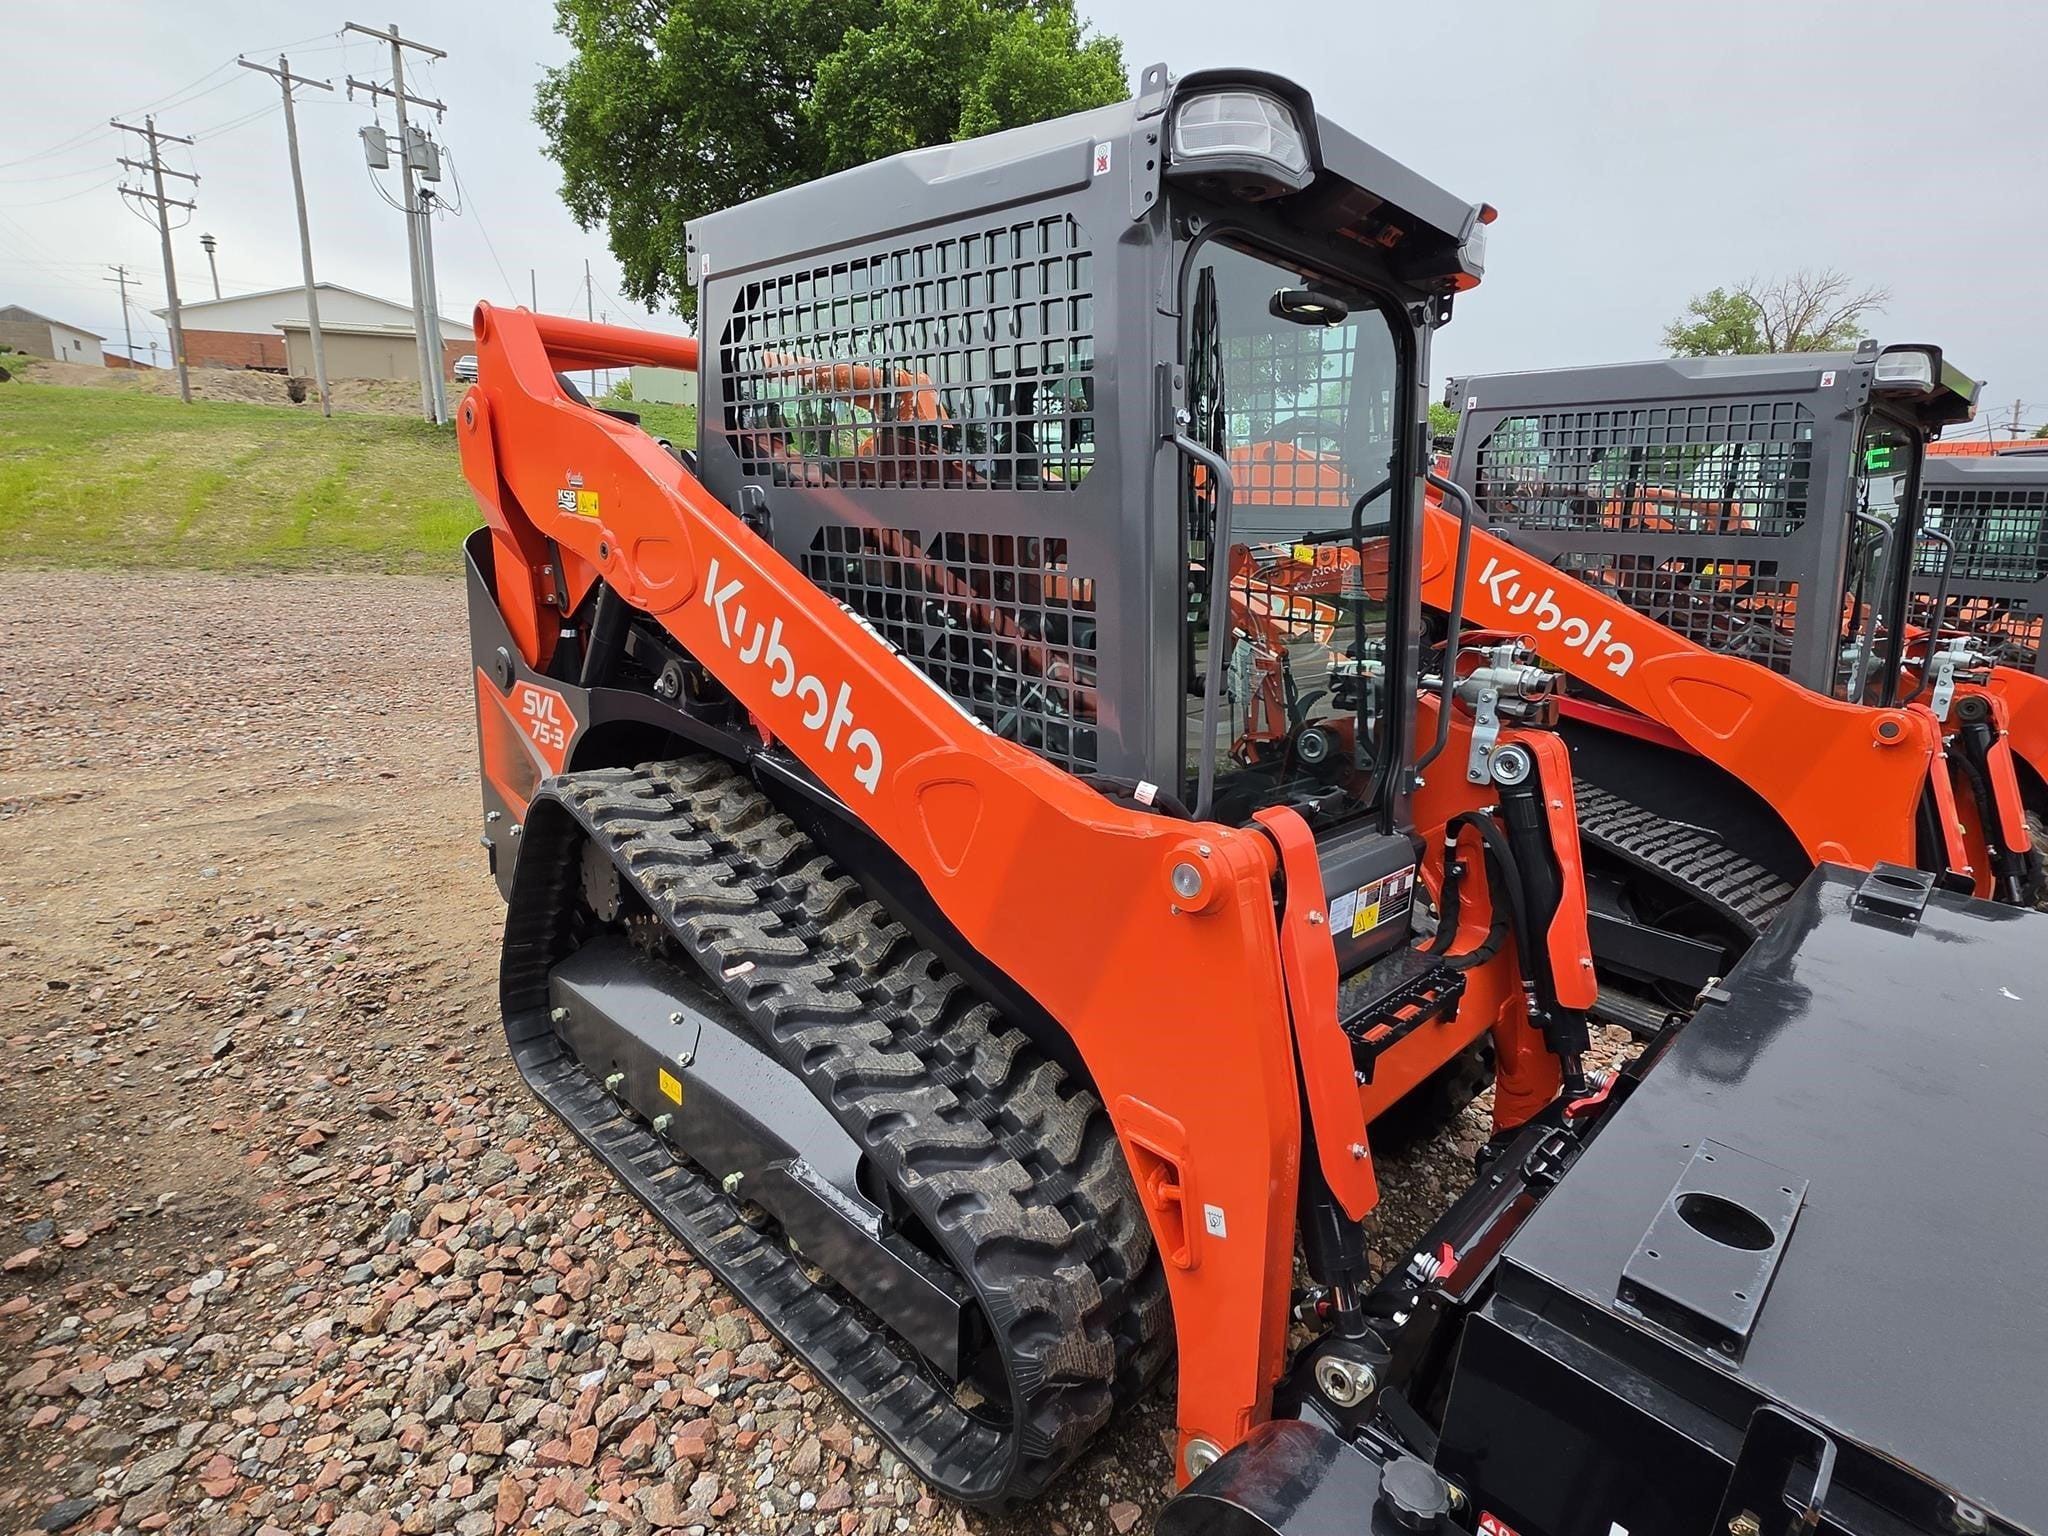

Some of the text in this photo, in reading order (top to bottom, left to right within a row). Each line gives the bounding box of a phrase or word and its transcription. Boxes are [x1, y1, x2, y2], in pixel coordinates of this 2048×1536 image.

[557, 489, 576, 502] KSR
[1478, 557, 1634, 677] Kubota
[704, 558, 883, 795] Kubota
[522, 689, 561, 725] SVL
[530, 719, 565, 751] 75-3
